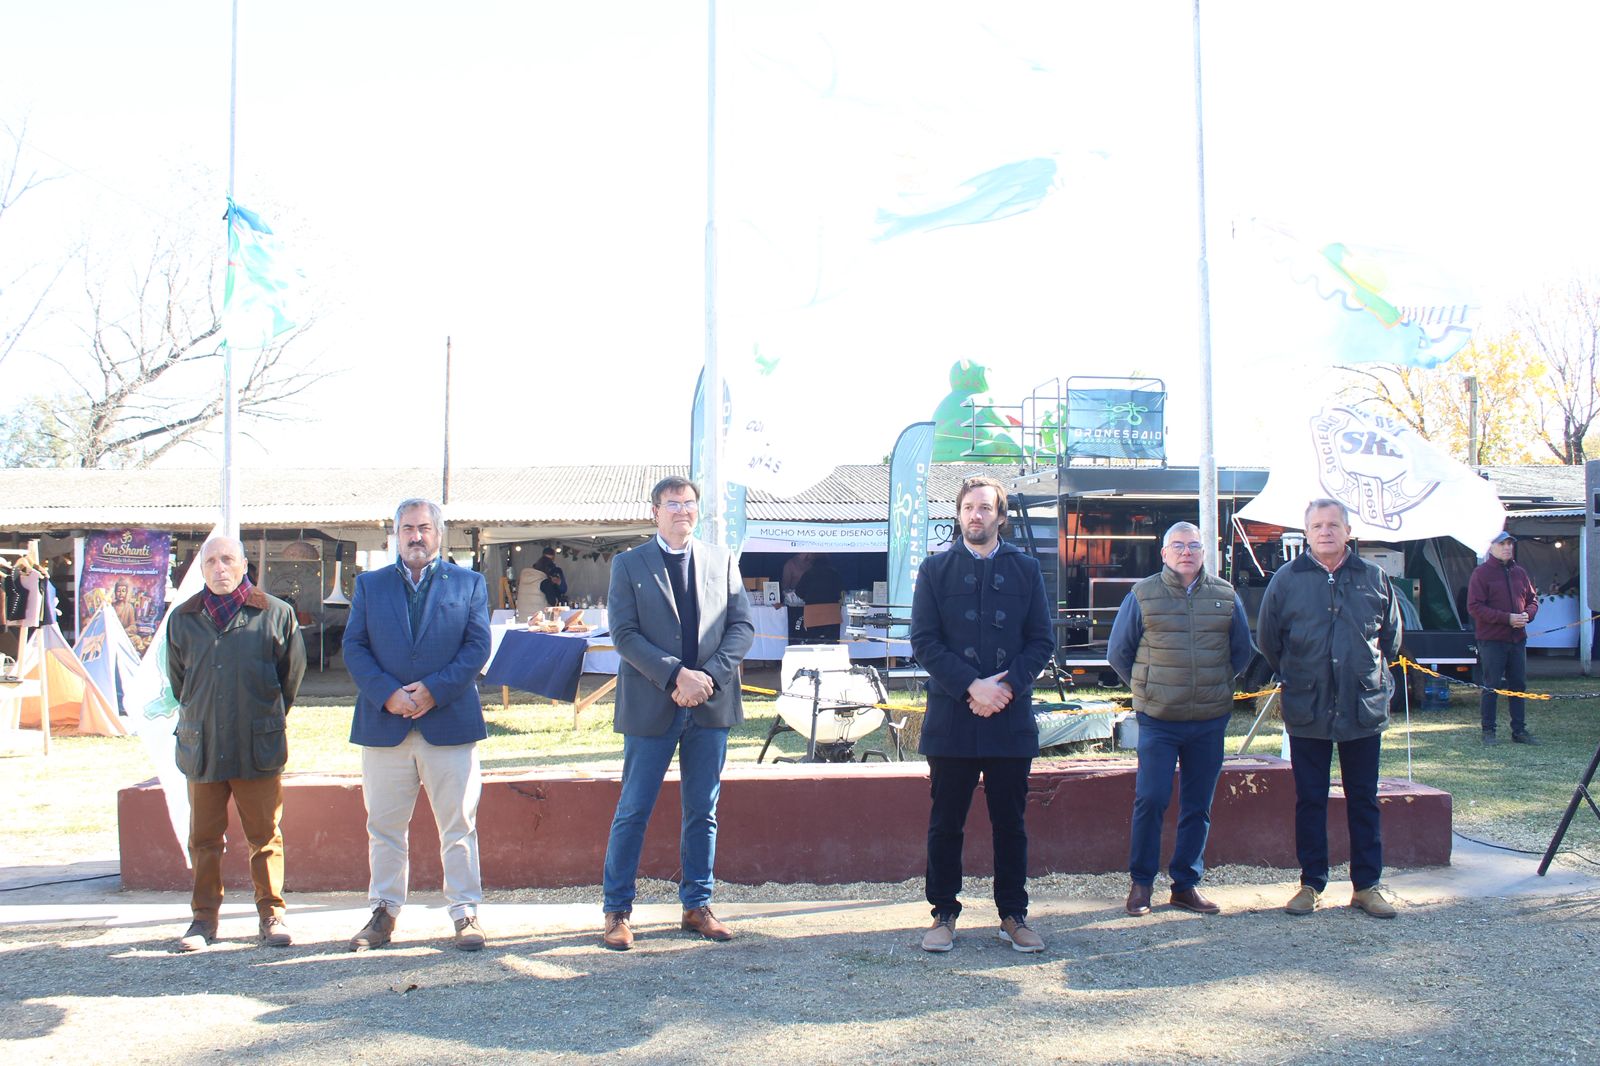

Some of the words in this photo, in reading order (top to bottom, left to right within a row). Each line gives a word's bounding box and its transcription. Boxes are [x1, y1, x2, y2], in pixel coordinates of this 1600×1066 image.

[1317, 415, 1341, 474] SOCIEDAD
[1362, 480, 1378, 519] 1969
[760, 528, 795, 537] MUCHO
[818, 529, 838, 537] QUE
[102, 542, 118, 555] Om
[119, 543, 151, 556] Shanti
